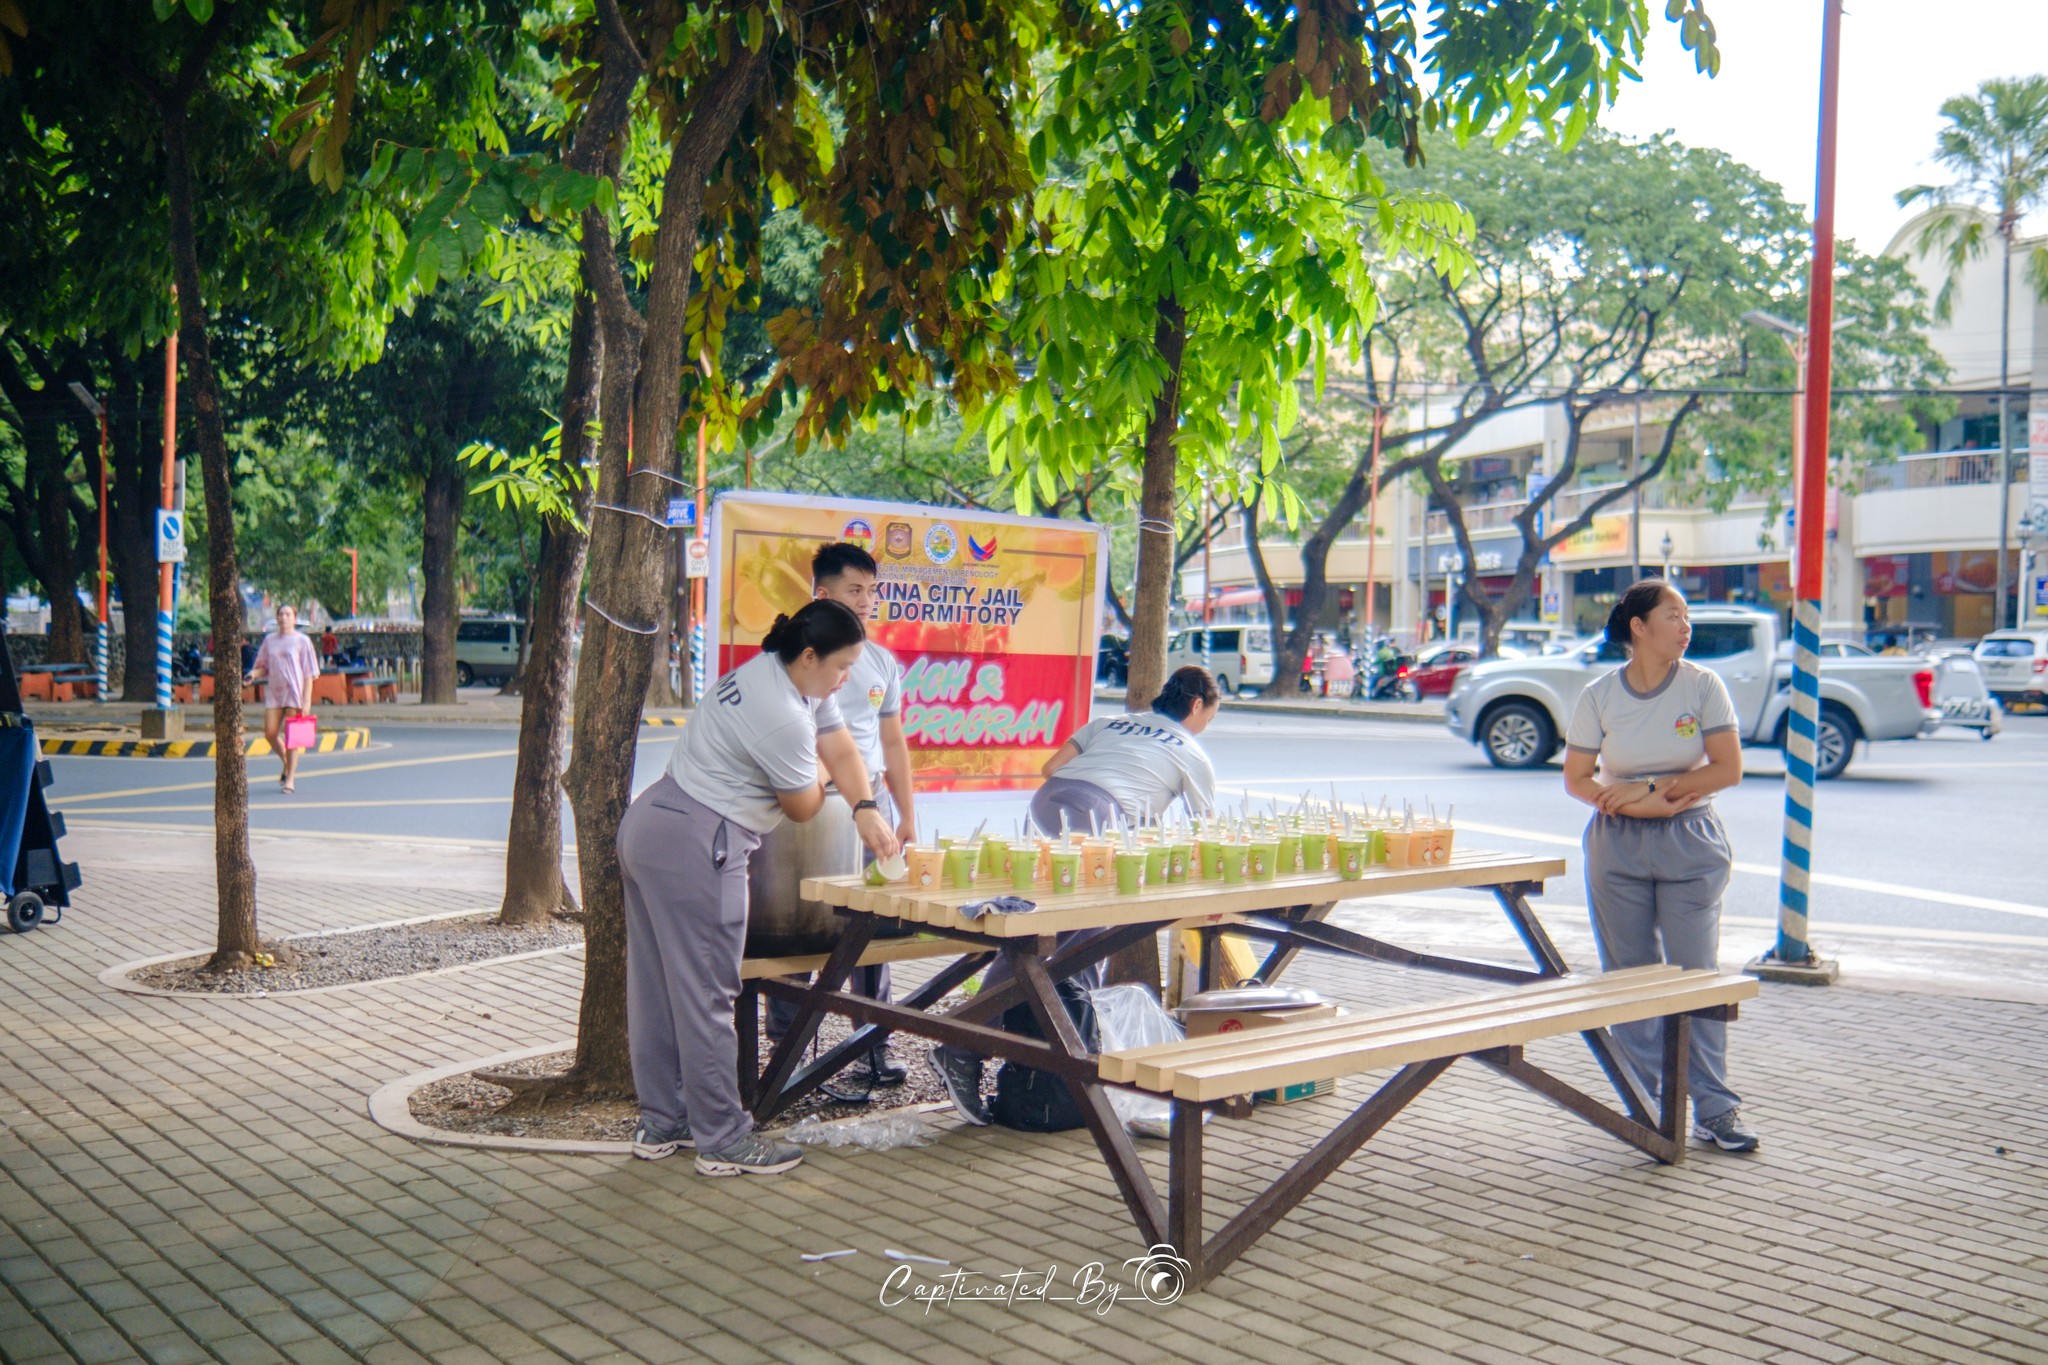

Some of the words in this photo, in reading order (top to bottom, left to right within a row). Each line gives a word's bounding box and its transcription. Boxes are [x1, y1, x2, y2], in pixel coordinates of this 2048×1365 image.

[876, 572, 907, 581] ATIONAL
[902, 565, 951, 576] MANAGEMENT
[876, 581, 921, 602] KINA
[928, 584, 976, 604] CITY
[980, 588, 1024, 608] JAIL
[887, 602, 1023, 626] DORMITORY
[899, 656, 972, 704] ACH
[968, 663, 1005, 702] &
[902, 698, 1063, 746] PROGRAM
